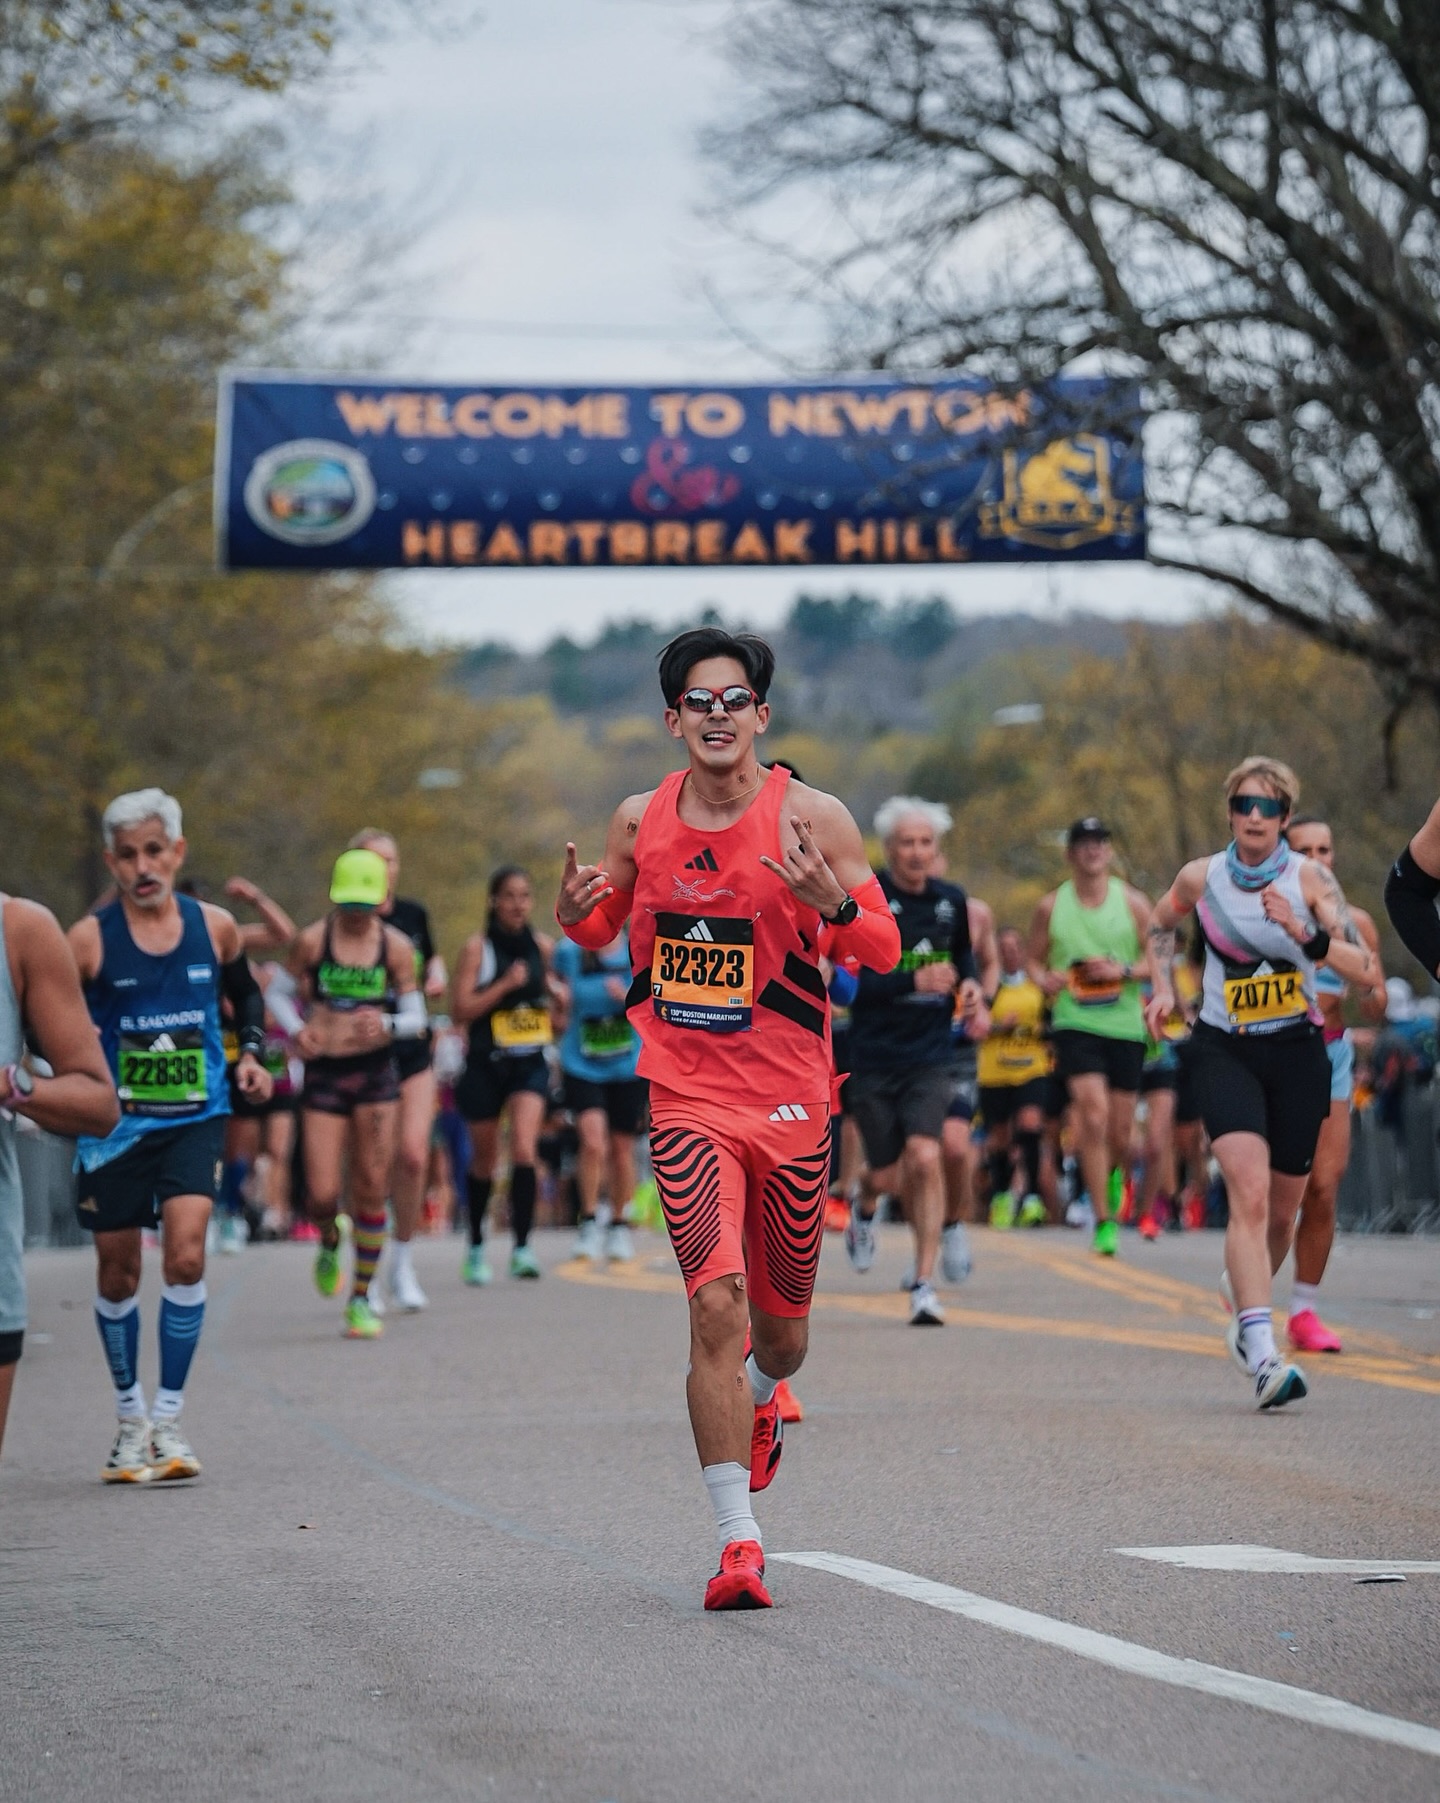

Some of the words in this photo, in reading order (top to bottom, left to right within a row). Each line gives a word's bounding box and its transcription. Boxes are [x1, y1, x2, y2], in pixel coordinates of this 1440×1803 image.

[336, 391, 630, 438] WELCOME
[653, 393, 745, 438] TO
[768, 389, 1031, 437] NEWTON
[402, 519, 812, 564] HEARTBREAK
[835, 519, 971, 563] HILL
[660, 942, 745, 988] 32323
[653, 984, 662, 996] 7
[120, 1015, 136, 1031] EL
[137, 1009, 205, 1029] SALVADOR
[682, 1010, 706, 1020] BOSTON
[706, 1013, 742, 1021] MARATHON
[125, 1055, 198, 1086] 22836
